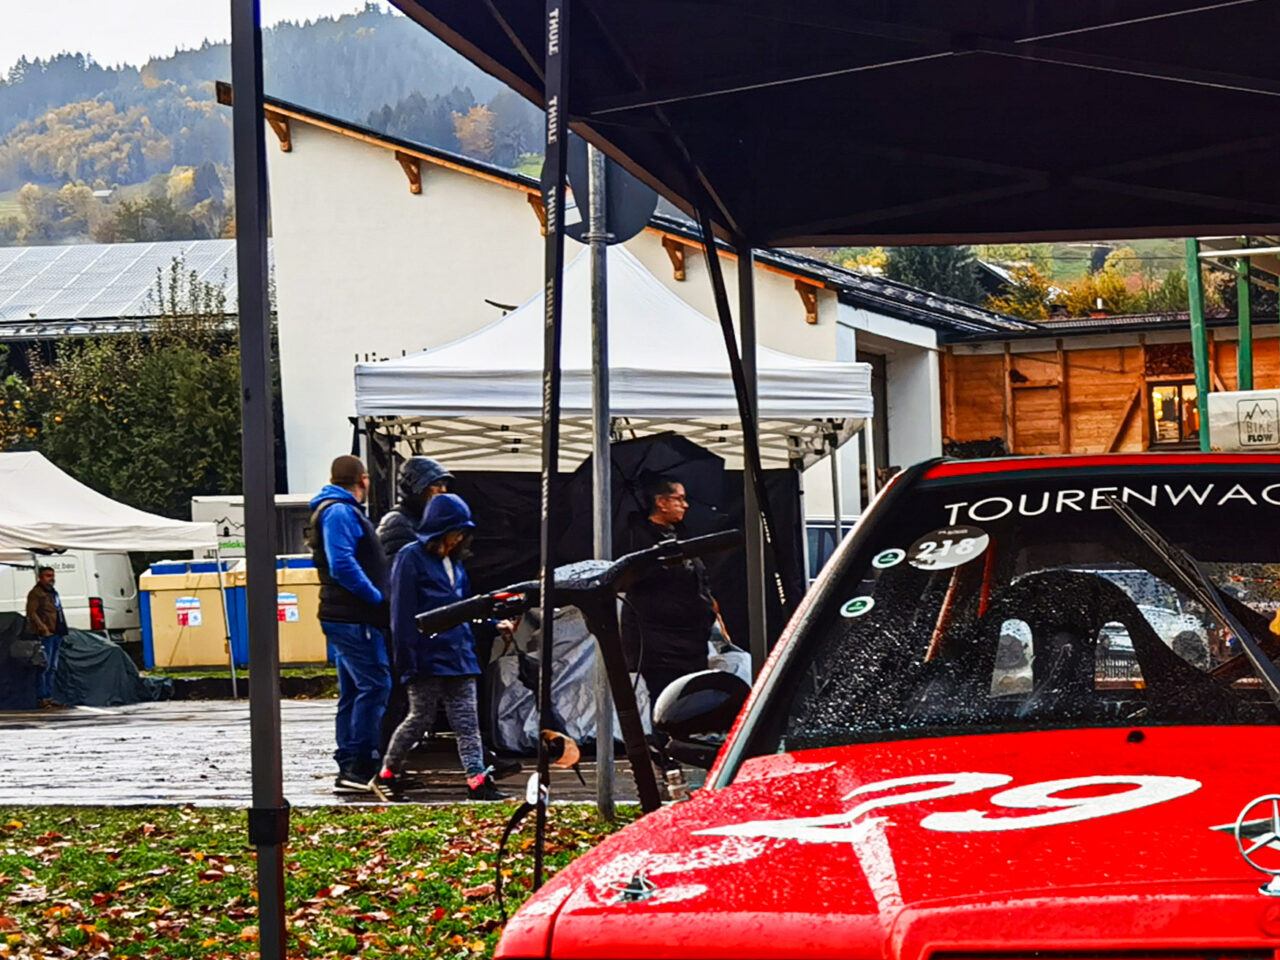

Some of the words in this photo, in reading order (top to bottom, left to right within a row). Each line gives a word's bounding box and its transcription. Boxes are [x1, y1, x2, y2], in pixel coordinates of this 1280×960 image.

[548, 8, 559, 56] THULE
[547, 96, 558, 145] THULE
[1247, 434, 1273, 442] FLOW
[915, 538, 977, 559] 218
